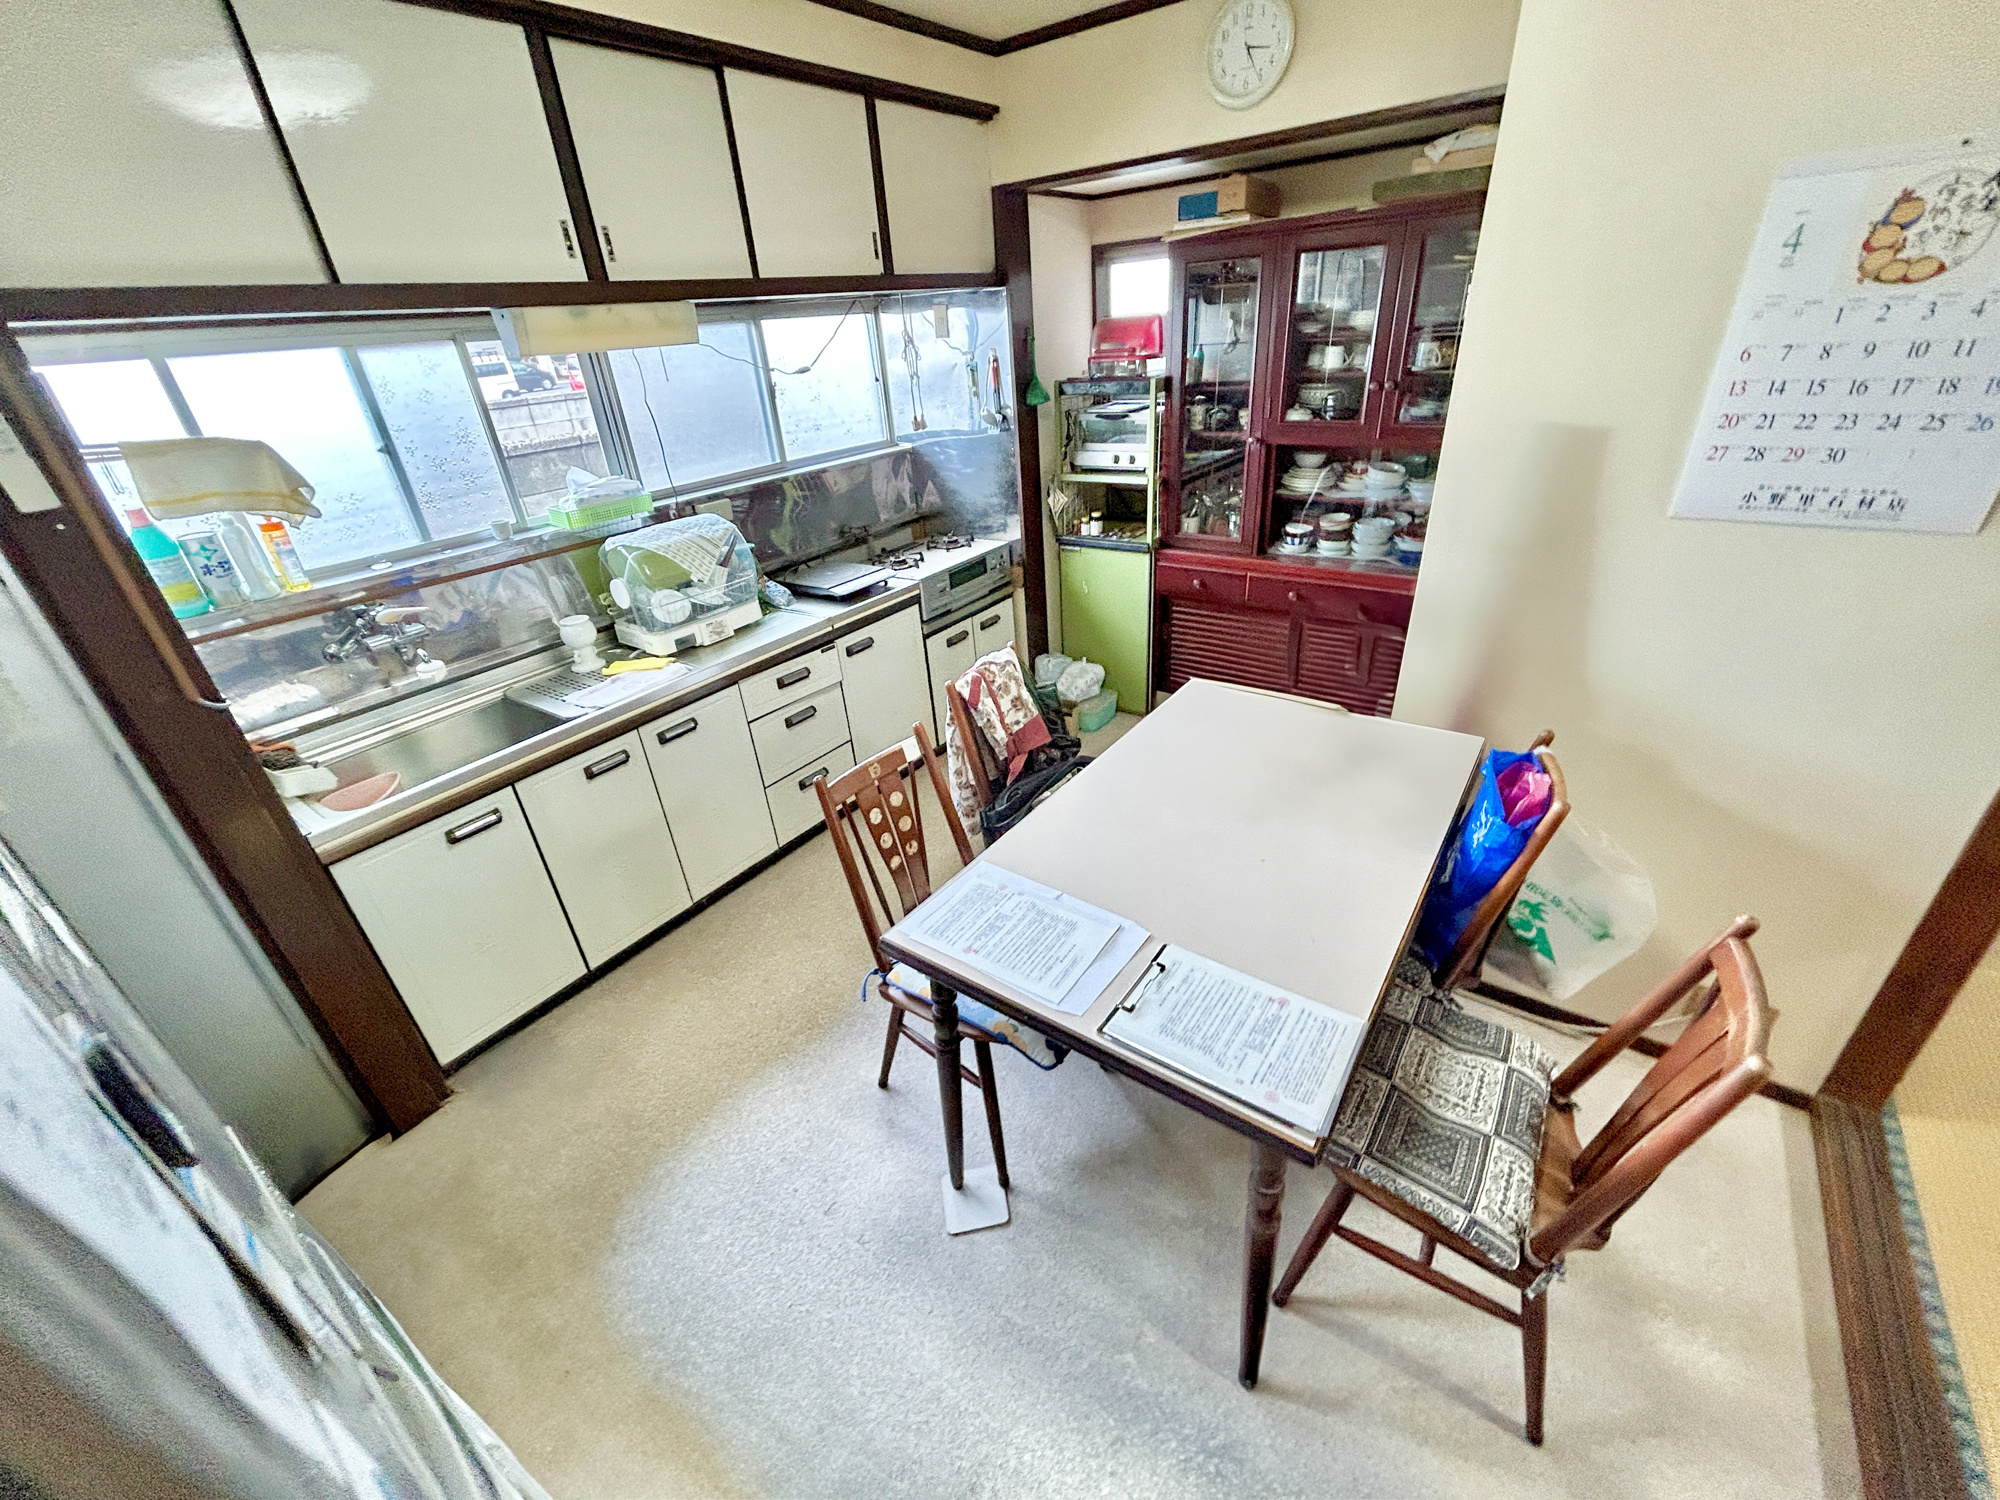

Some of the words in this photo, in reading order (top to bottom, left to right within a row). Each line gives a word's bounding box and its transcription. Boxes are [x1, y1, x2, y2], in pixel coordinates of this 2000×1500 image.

[1781, 222, 1803, 254] 4
[1835, 306, 1844, 324] 1
[1875, 303, 1891, 323] 2
[1921, 301, 1938, 321] 3
[1971, 299, 1987, 318] 4
[1740, 346, 1751, 362] 6
[1781, 344, 1793, 362] 7
[1819, 344, 1833, 360] 8
[1864, 342, 1877, 359] 9
[1906, 340, 1931, 359] 10
[1953, 338, 1977, 357] 11
[1729, 379, 1747, 397] 13
[1767, 379, 1787, 396] 14
[1806, 379, 1827, 396] 15
[1848, 379, 1869, 396] 16
[1890, 377, 1915, 396] 17
[1937, 377, 1961, 395] 18
[1717, 413, 1740, 430] 20
[1755, 413, 1776, 430] 21
[1793, 413, 1818, 430] 22
[1833, 413, 1859, 430] 23
[1875, 413, 1902, 431] 24
[1919, 413, 1949, 432] 25
[1966, 411, 1994, 432] 26
[1707, 445, 1729, 462] 27
[1743, 445, 1767, 462] 28
[1781, 446, 1805, 463] 29
[1820, 446, 1846, 464] 30
